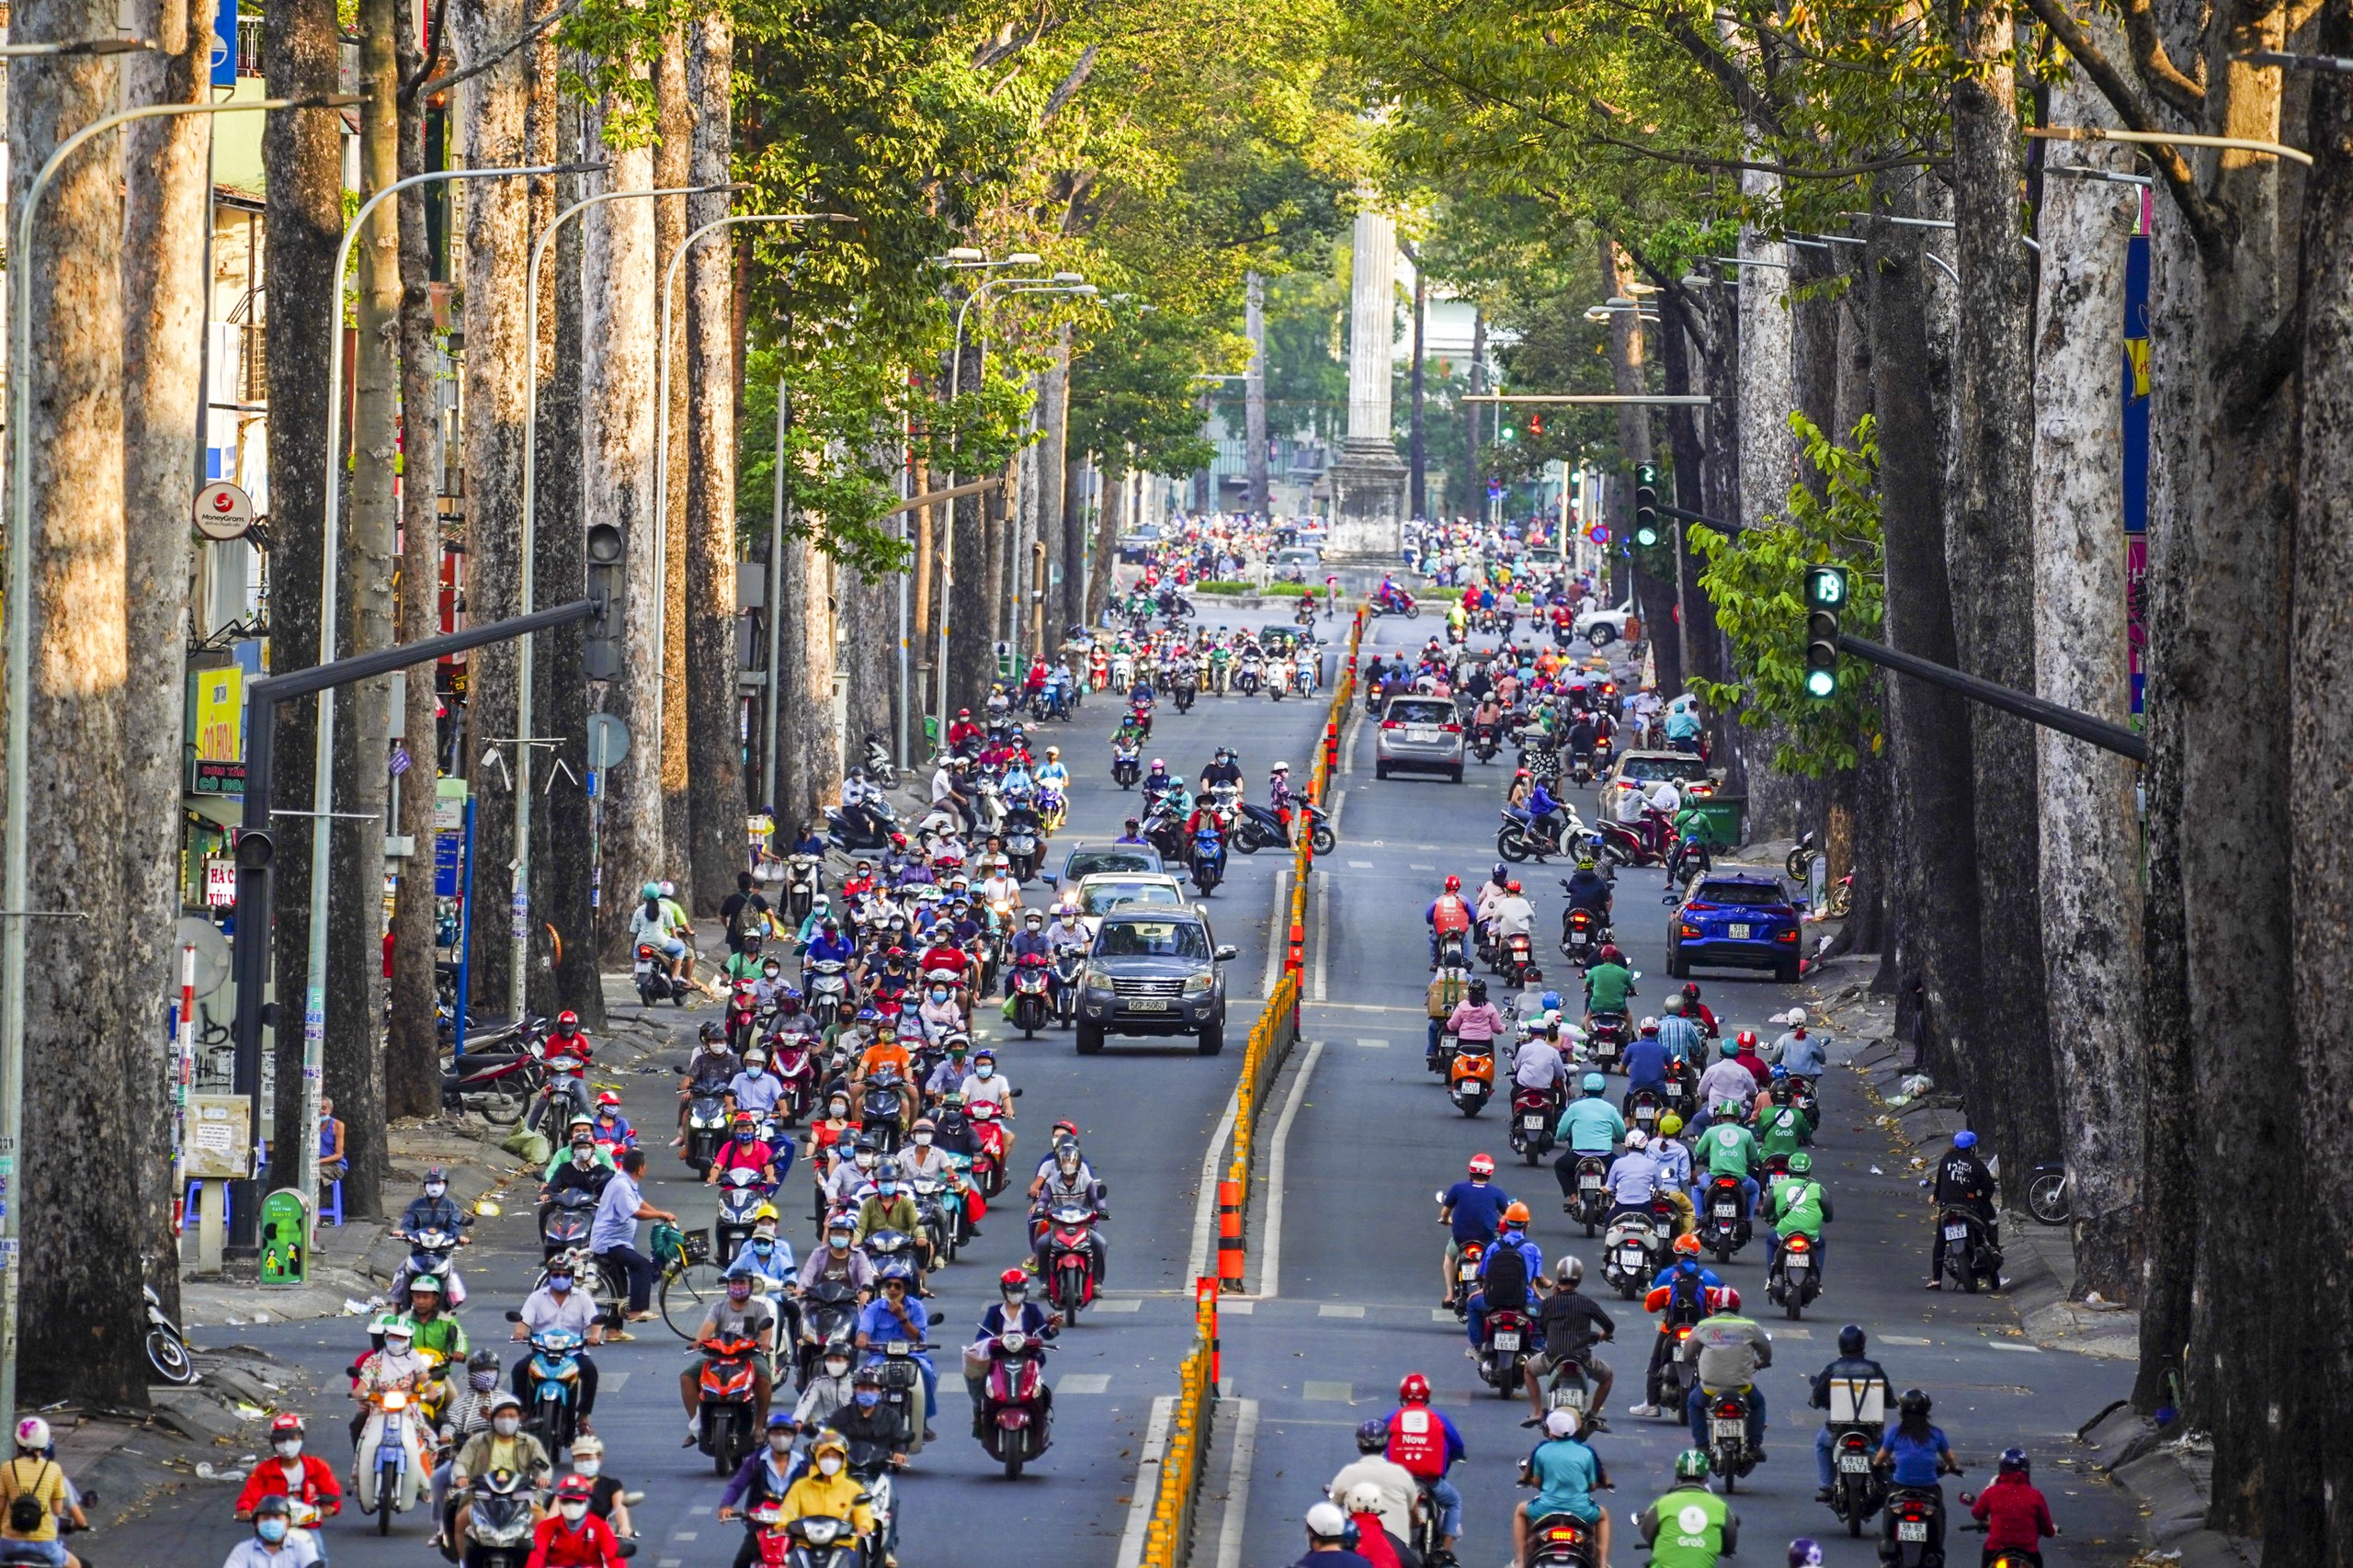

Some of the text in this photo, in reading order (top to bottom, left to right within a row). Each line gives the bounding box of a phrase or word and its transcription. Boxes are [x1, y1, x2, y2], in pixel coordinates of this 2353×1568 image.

[202, 514, 244, 522] MoneyGram
[216, 722, 233, 760] HOA
[199, 776, 219, 791] CÔ
[210, 864, 225, 883] HÁ
[1719, 1149, 1738, 1157] Grab
[1402, 1434, 1427, 1444] Now
[1677, 1536, 1706, 1548] Grab
